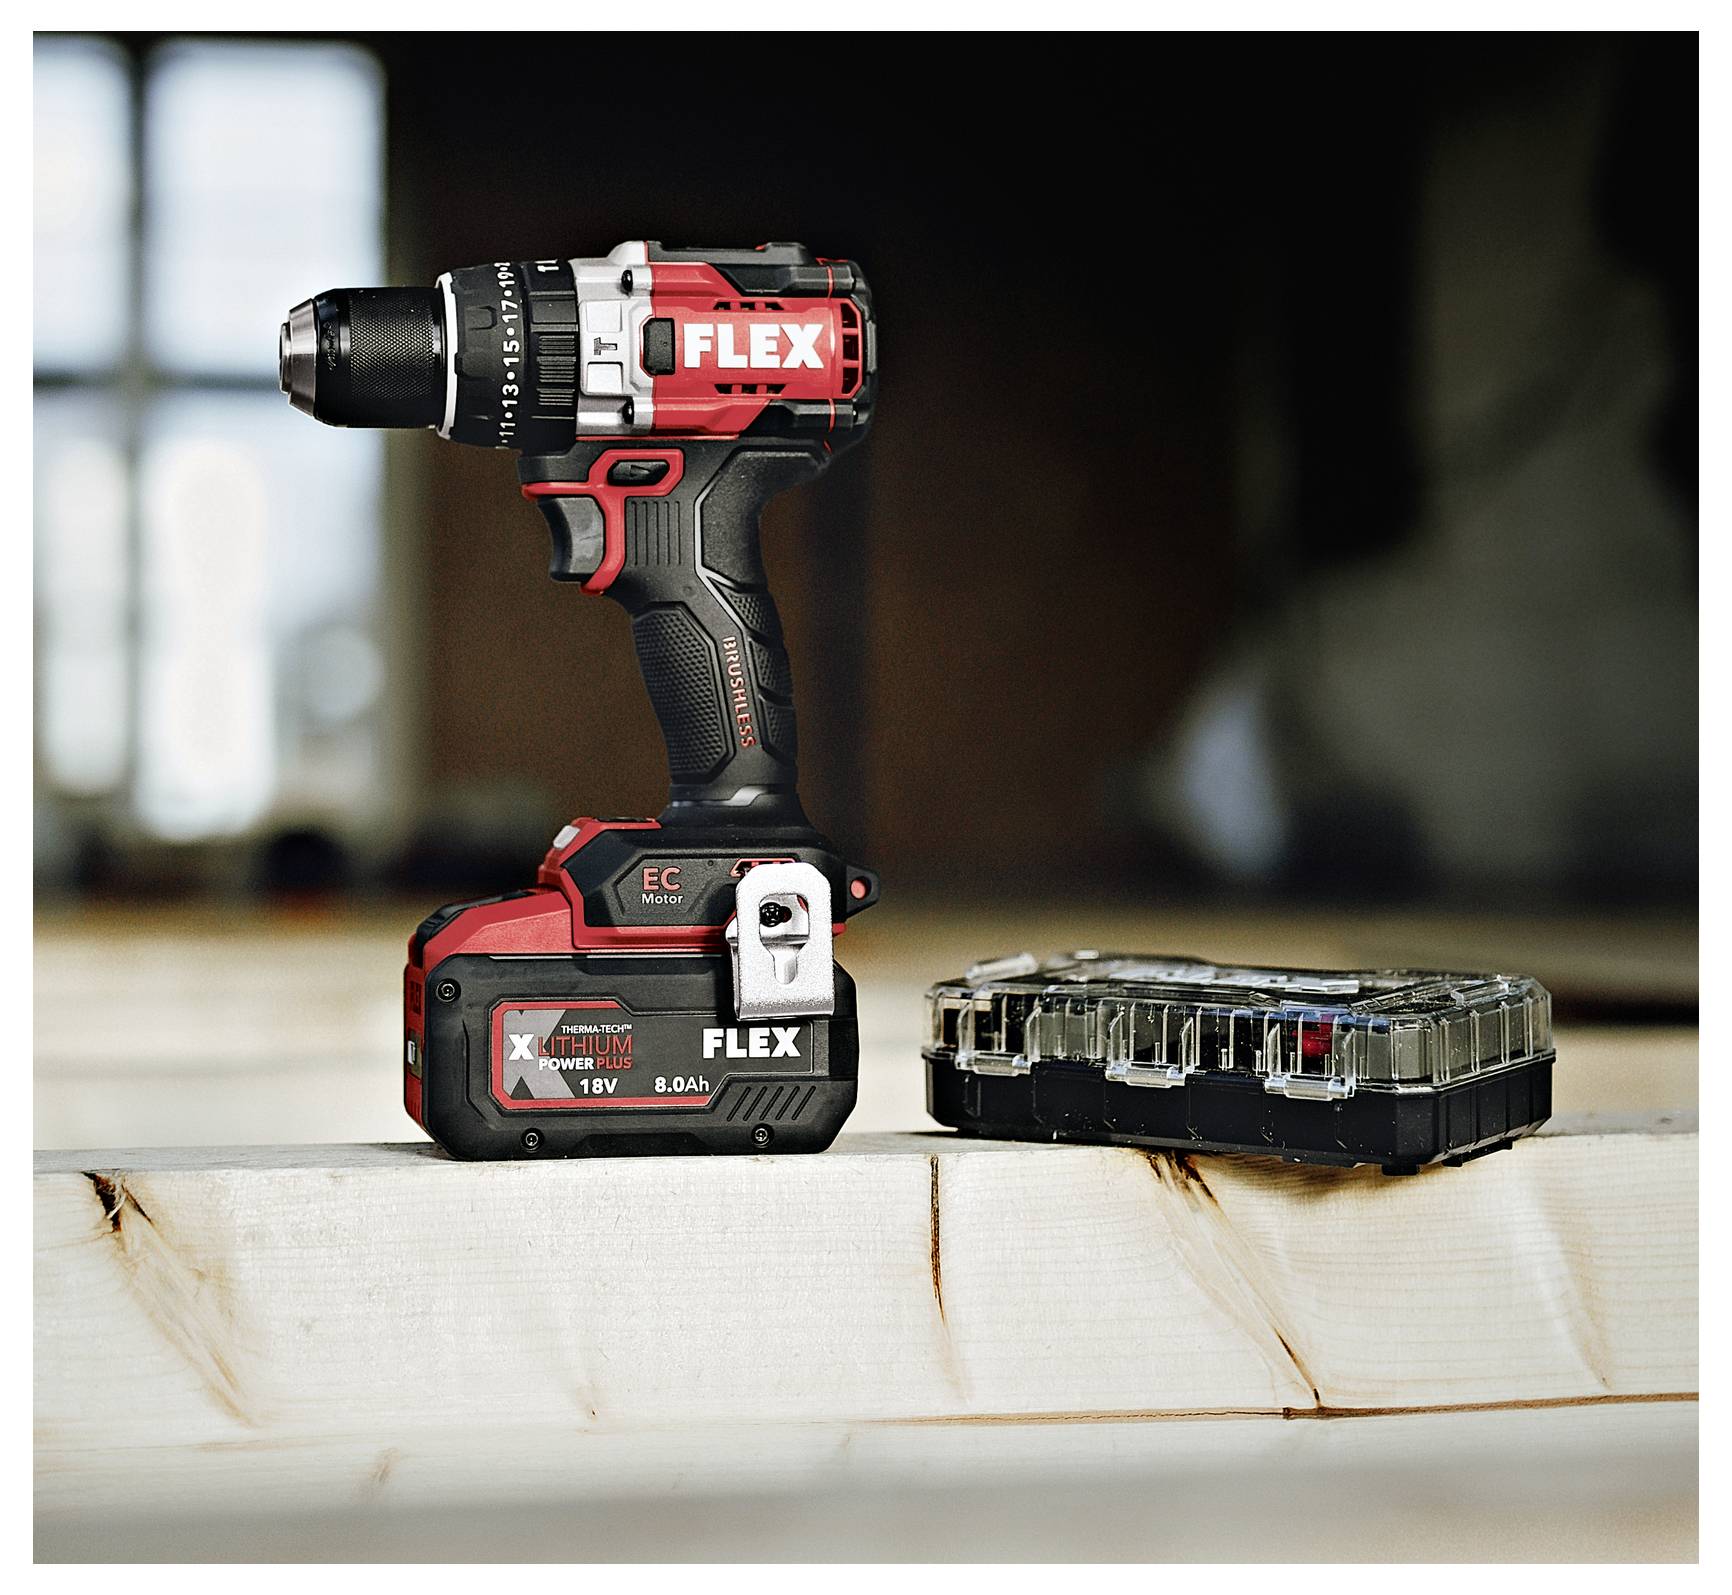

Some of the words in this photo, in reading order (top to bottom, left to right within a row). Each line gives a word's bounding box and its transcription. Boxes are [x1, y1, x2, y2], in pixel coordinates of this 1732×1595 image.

[497, 271, 515, 288] 19
[501, 300, 518, 323] 17
[503, 340, 520, 367] 15
[683, 323, 825, 369] FLEX
[502, 384, 519, 408] 13
[723, 636, 757, 748] BRUSHLESS
[642, 866, 682, 891] EC
[641, 893, 683, 905] Motor
[508, 1033, 534, 1061] X
[538, 1034, 633, 1057] LITHIUM
[702, 1027, 801, 1059] FLEX
[538, 1057, 594, 1071] POWER
[596, 1056, 632, 1070] PLUS
[579, 1077, 618, 1095] 18V
[654, 1075, 710, 1093] 8.0Ah
